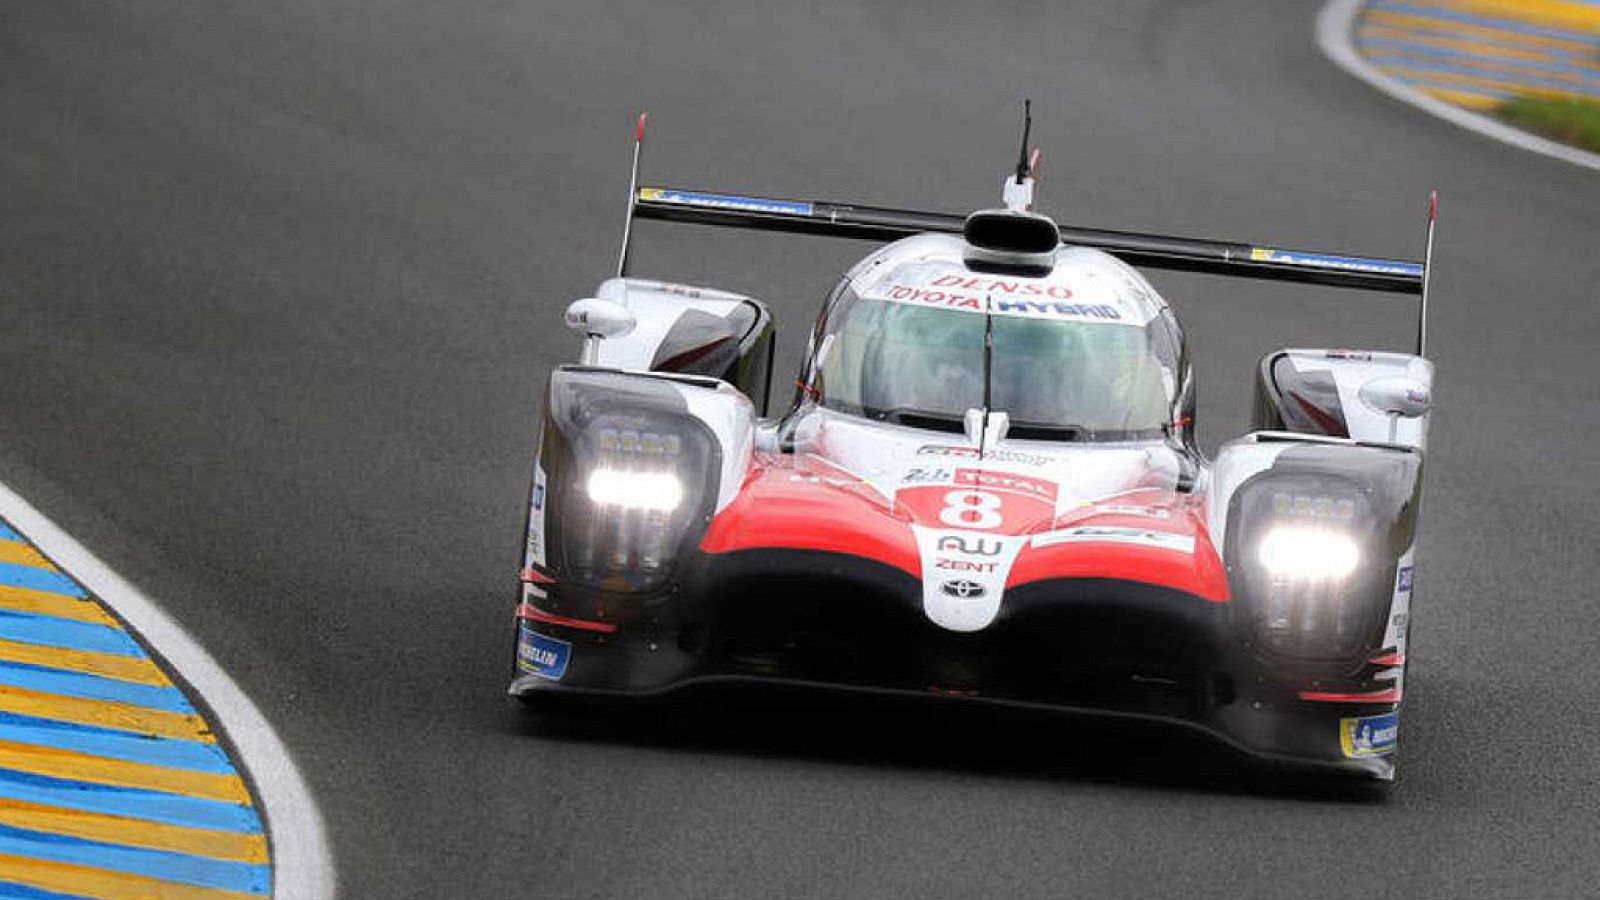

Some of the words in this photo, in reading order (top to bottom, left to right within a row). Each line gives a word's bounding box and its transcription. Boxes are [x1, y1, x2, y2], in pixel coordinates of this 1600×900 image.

[932, 274, 1073, 299] DENSO
[887, 285, 981, 309] TOYOTA
[998, 301, 1121, 320] HYBRID
[960, 472, 1050, 495] TOTAL
[938, 490, 1002, 529] 8
[935, 558, 1000, 573] ZENT
